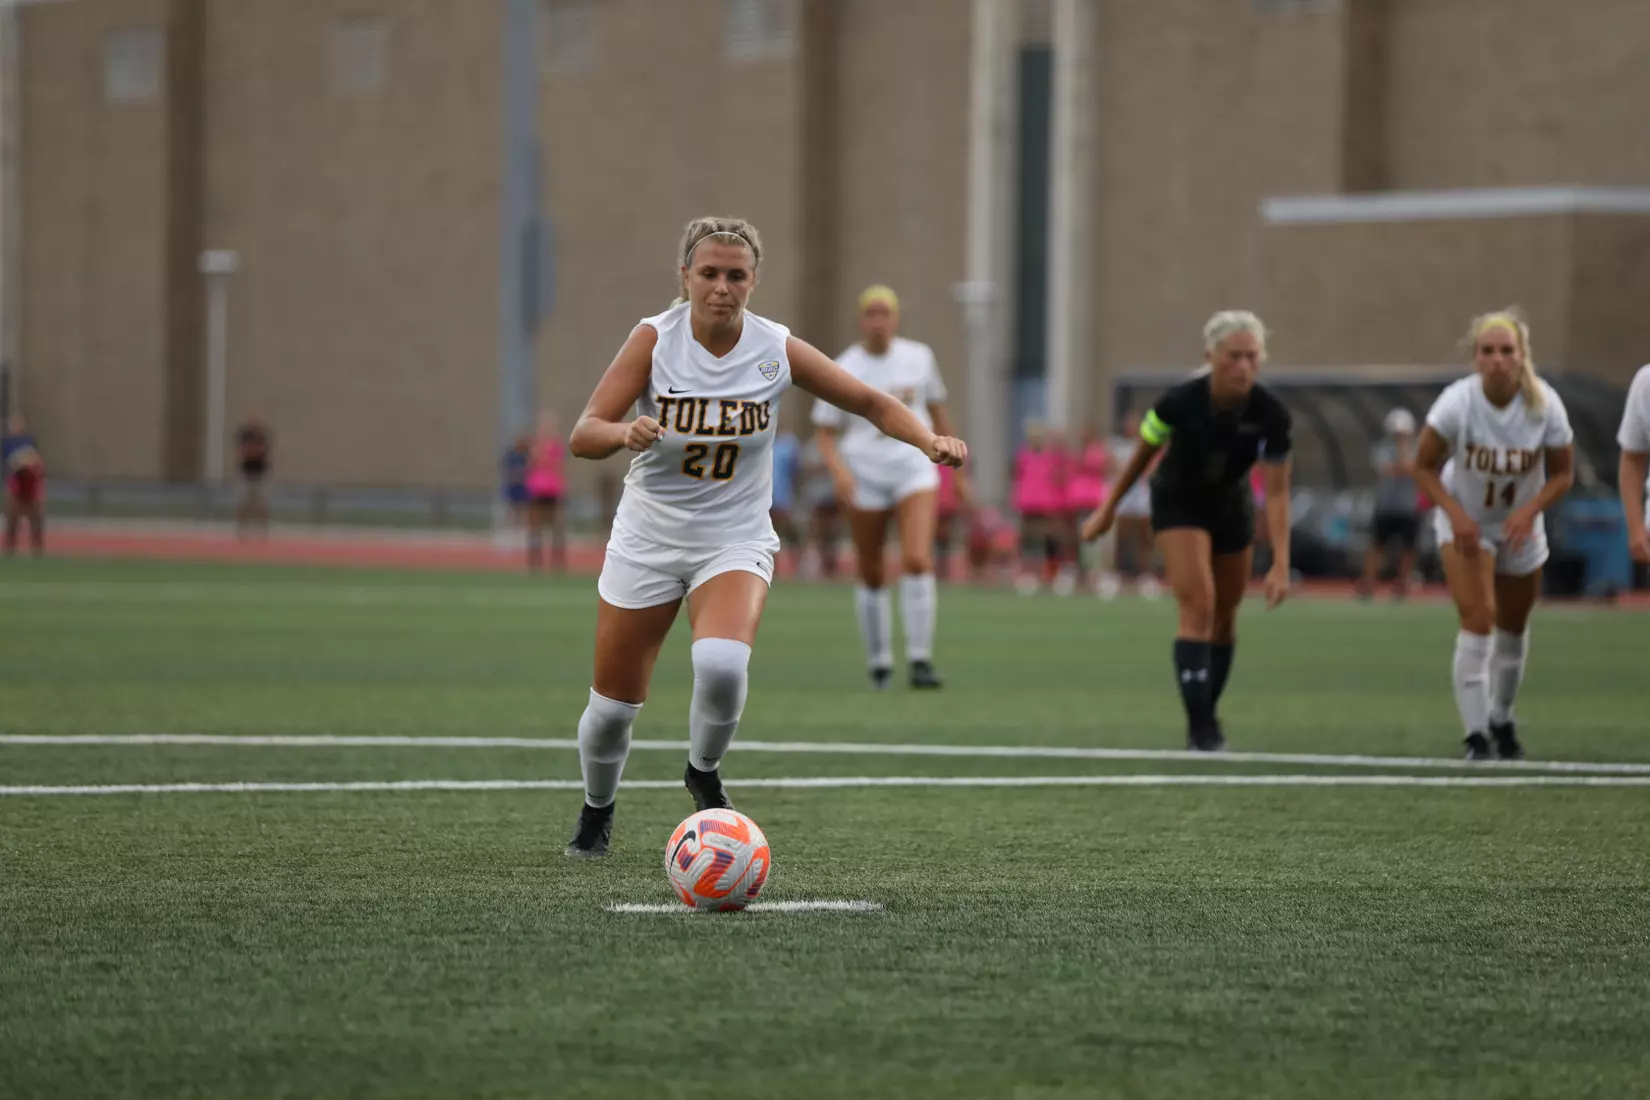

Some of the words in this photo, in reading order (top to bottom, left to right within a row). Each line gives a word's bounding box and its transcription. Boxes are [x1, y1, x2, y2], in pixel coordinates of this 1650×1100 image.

[656, 394, 770, 436] TOLEDO
[681, 441, 740, 482] 20
[1484, 480, 1516, 510] 14
